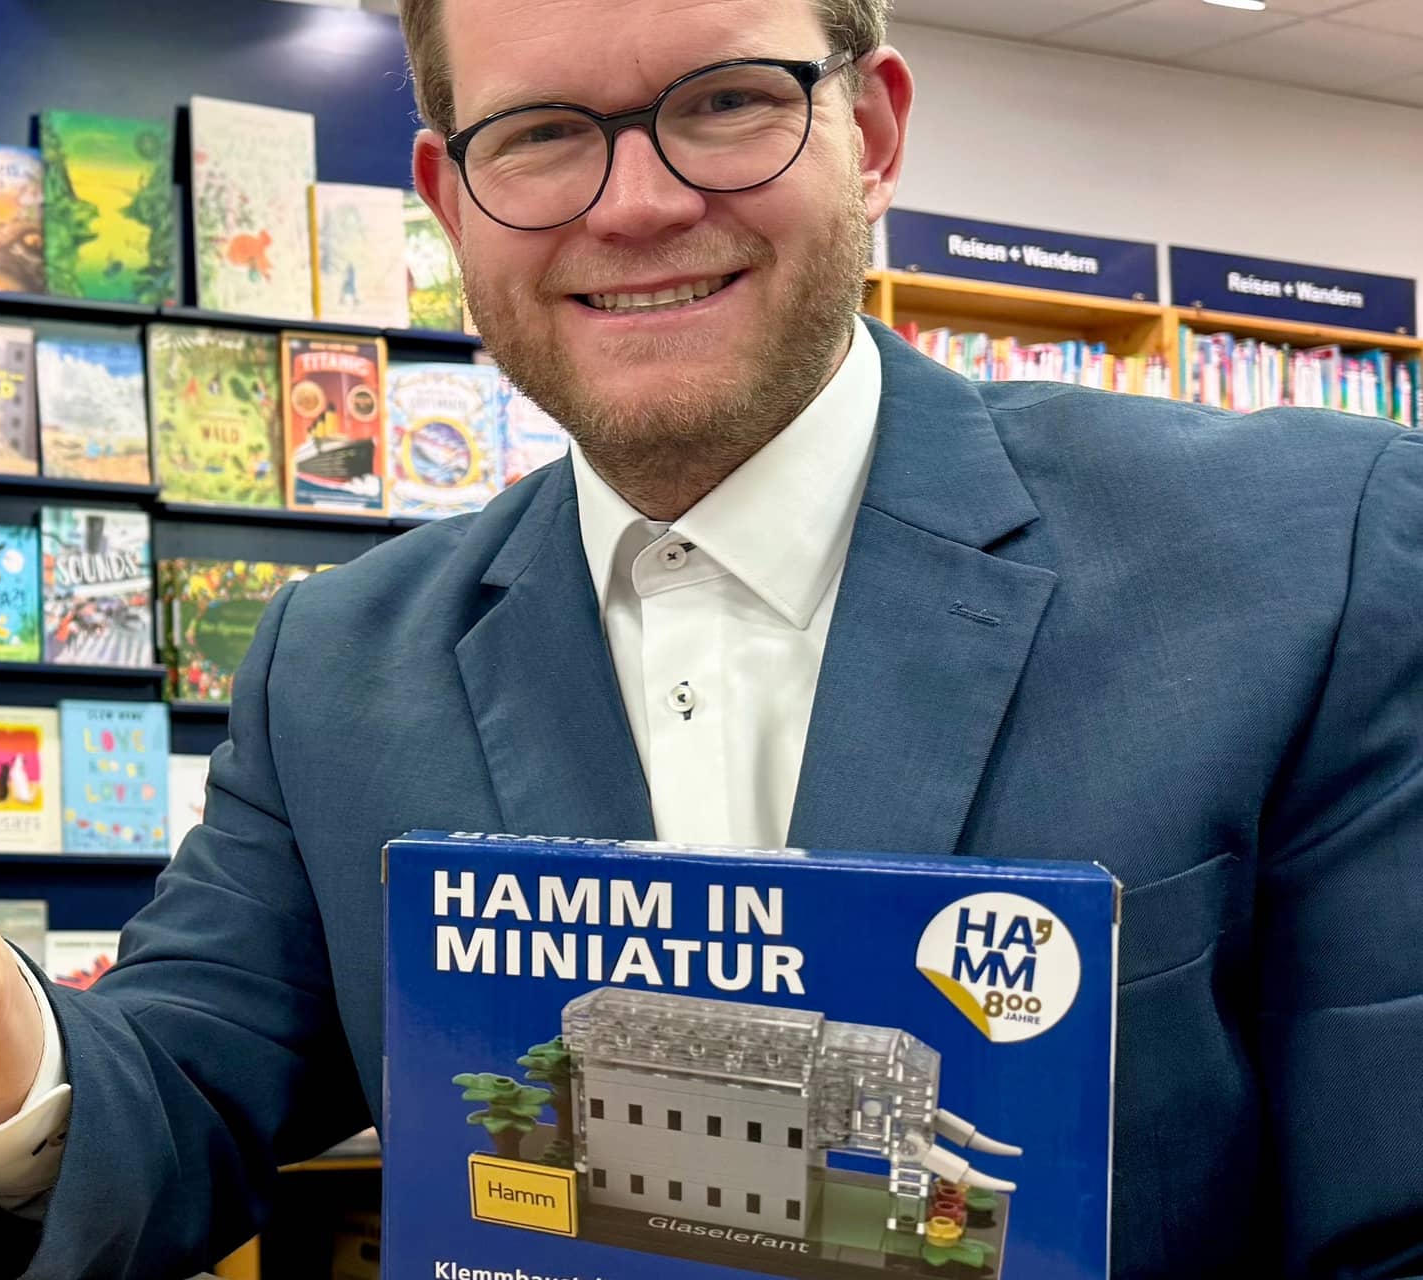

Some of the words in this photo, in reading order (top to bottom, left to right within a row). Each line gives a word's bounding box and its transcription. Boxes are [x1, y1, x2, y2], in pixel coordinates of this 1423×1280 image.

[948, 234, 1006, 264] Reisen
[1008, 247, 1021, 263] +
[1022, 246, 1098, 275] Wandern
[1227, 272, 1281, 299] Reisen
[1283, 284, 1295, 298] +
[1296, 283, 1363, 309] Wandern
[302, 354, 370, 375] TITANIC
[200, 424, 240, 444] WALD
[55, 550, 138, 586] SOUNDS
[433, 869, 673, 930] HAMM
[708, 884, 783, 936] IN
[435, 925, 807, 996] MINIATUR
[983, 990, 1042, 1018] 800
[1003, 1012, 1041, 1025] JAHRE
[488, 1180, 556, 1209] Hamm
[647, 1215, 810, 1254] Glaselefant
